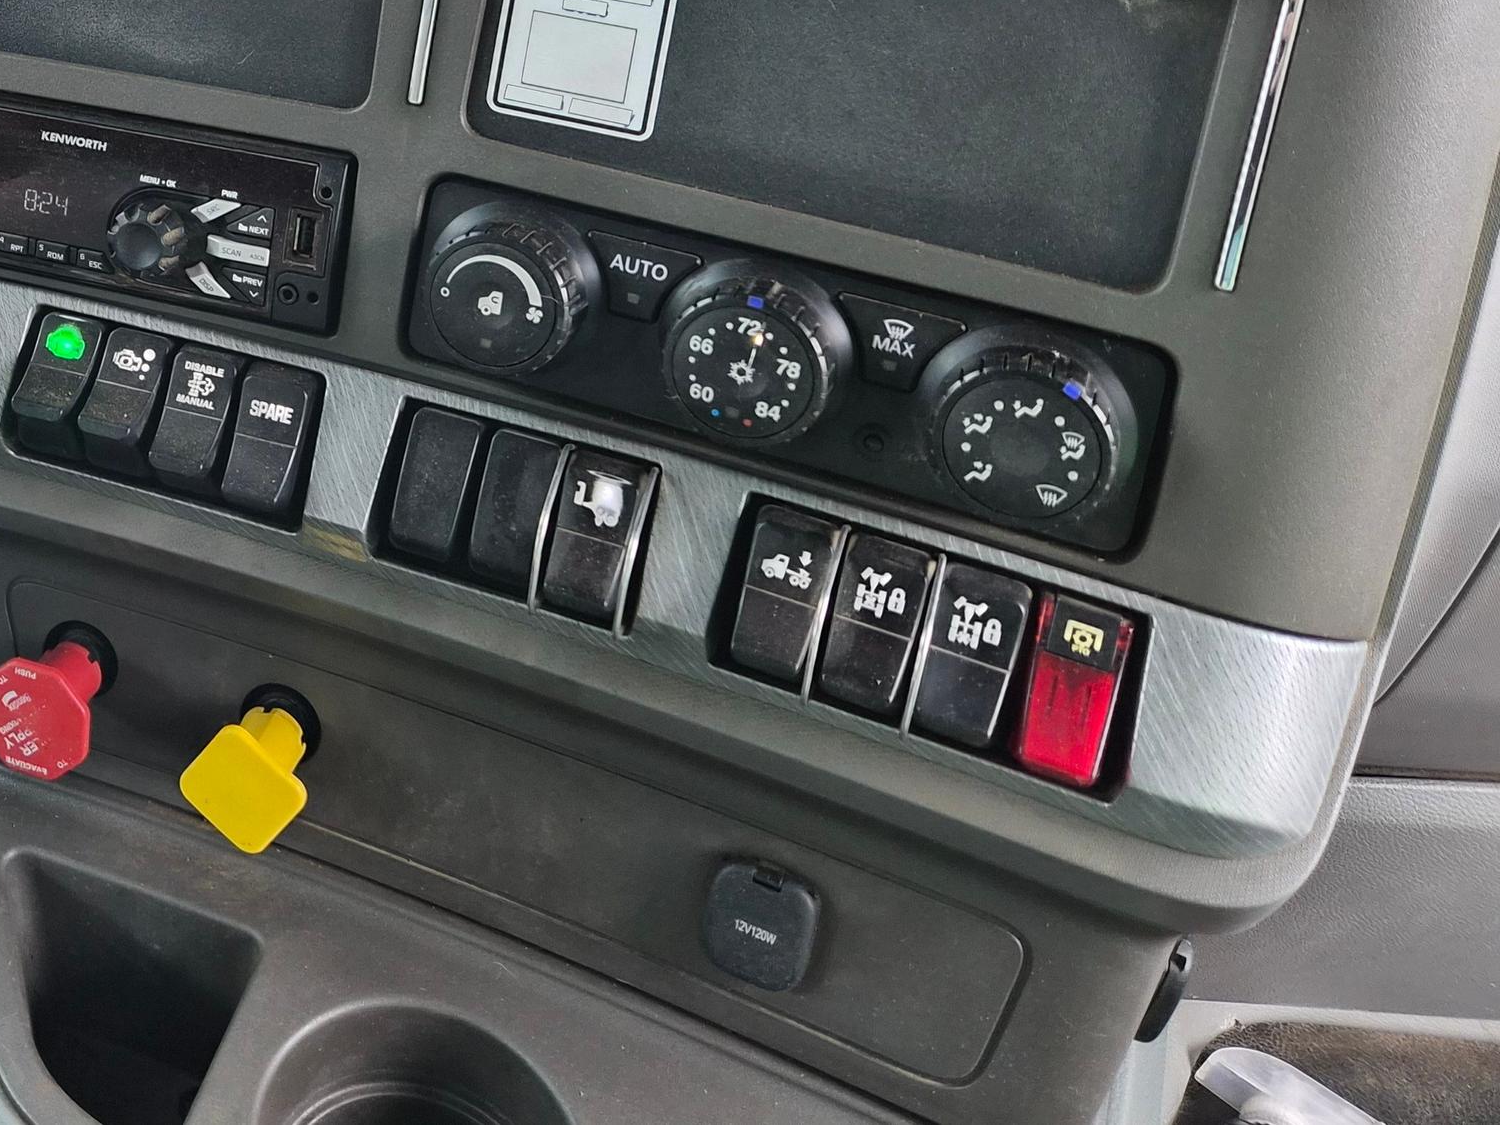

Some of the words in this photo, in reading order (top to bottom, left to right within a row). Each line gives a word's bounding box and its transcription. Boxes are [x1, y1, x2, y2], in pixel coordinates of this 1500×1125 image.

[41, 130, 107, 152] KENWORTH
[140, 174, 160, 185] MENU
[166, 178, 177, 188] OK
[24, 188, 69, 216] 8:24
[221, 189, 238, 200] PWR
[249, 226, 269, 235] NEXT
[10, 244, 24, 252] RPT
[222, 247, 242, 257] SCAN
[88, 261, 102, 269] ESC
[609, 253, 669, 282] AUTO
[243, 276, 263, 287] PREV
[738, 317, 762, 336] 72
[689, 335, 714, 355] 66
[872, 334, 916, 359] MAX
[184, 360, 224, 378] DISABLE
[776, 358, 801, 379] 78
[175, 393, 215, 411] MANUAL
[689, 383, 714, 403] 60
[249, 399, 294, 425] SPARE
[755, 401, 781, 422] 84
[15, 667, 36, 680] PUSH
[6, 756, 48, 776] EVACUATE
[57, 759, 68, 769] TO
[734, 918, 778, 946] 12V120W
